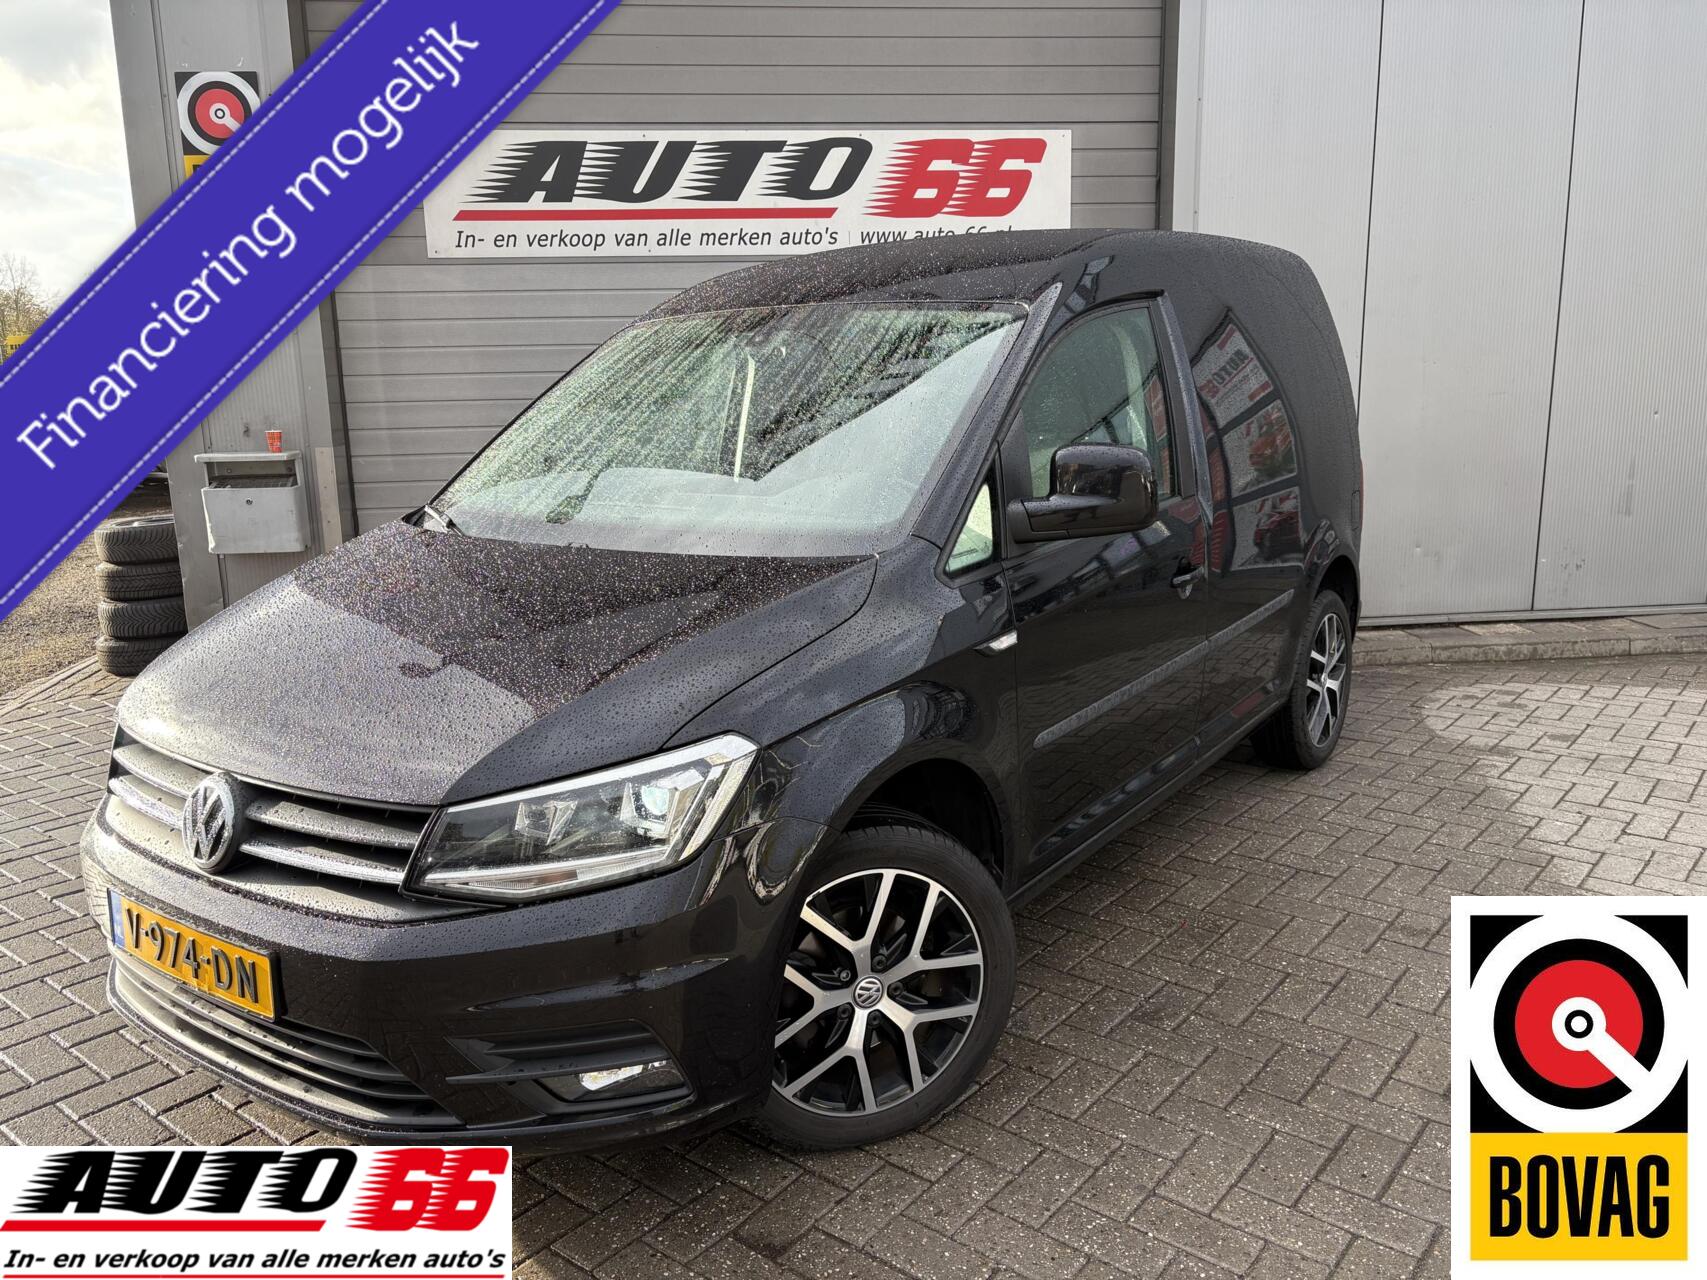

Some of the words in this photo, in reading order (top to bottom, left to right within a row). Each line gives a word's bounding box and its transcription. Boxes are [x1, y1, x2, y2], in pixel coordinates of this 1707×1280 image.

[458, 137, 873, 204] AUTO
[861, 138, 1047, 218] 66
[455, 231, 485, 248] In-
[493, 233, 517, 248] en
[526, 230, 606, 251] verkoop
[614, 232, 648, 247] van
[656, 229, 691, 247] alle
[699, 228, 772, 246] merken
[779, 226, 839, 246] auto's
[126, 908, 259, 1003] V-974-DN
